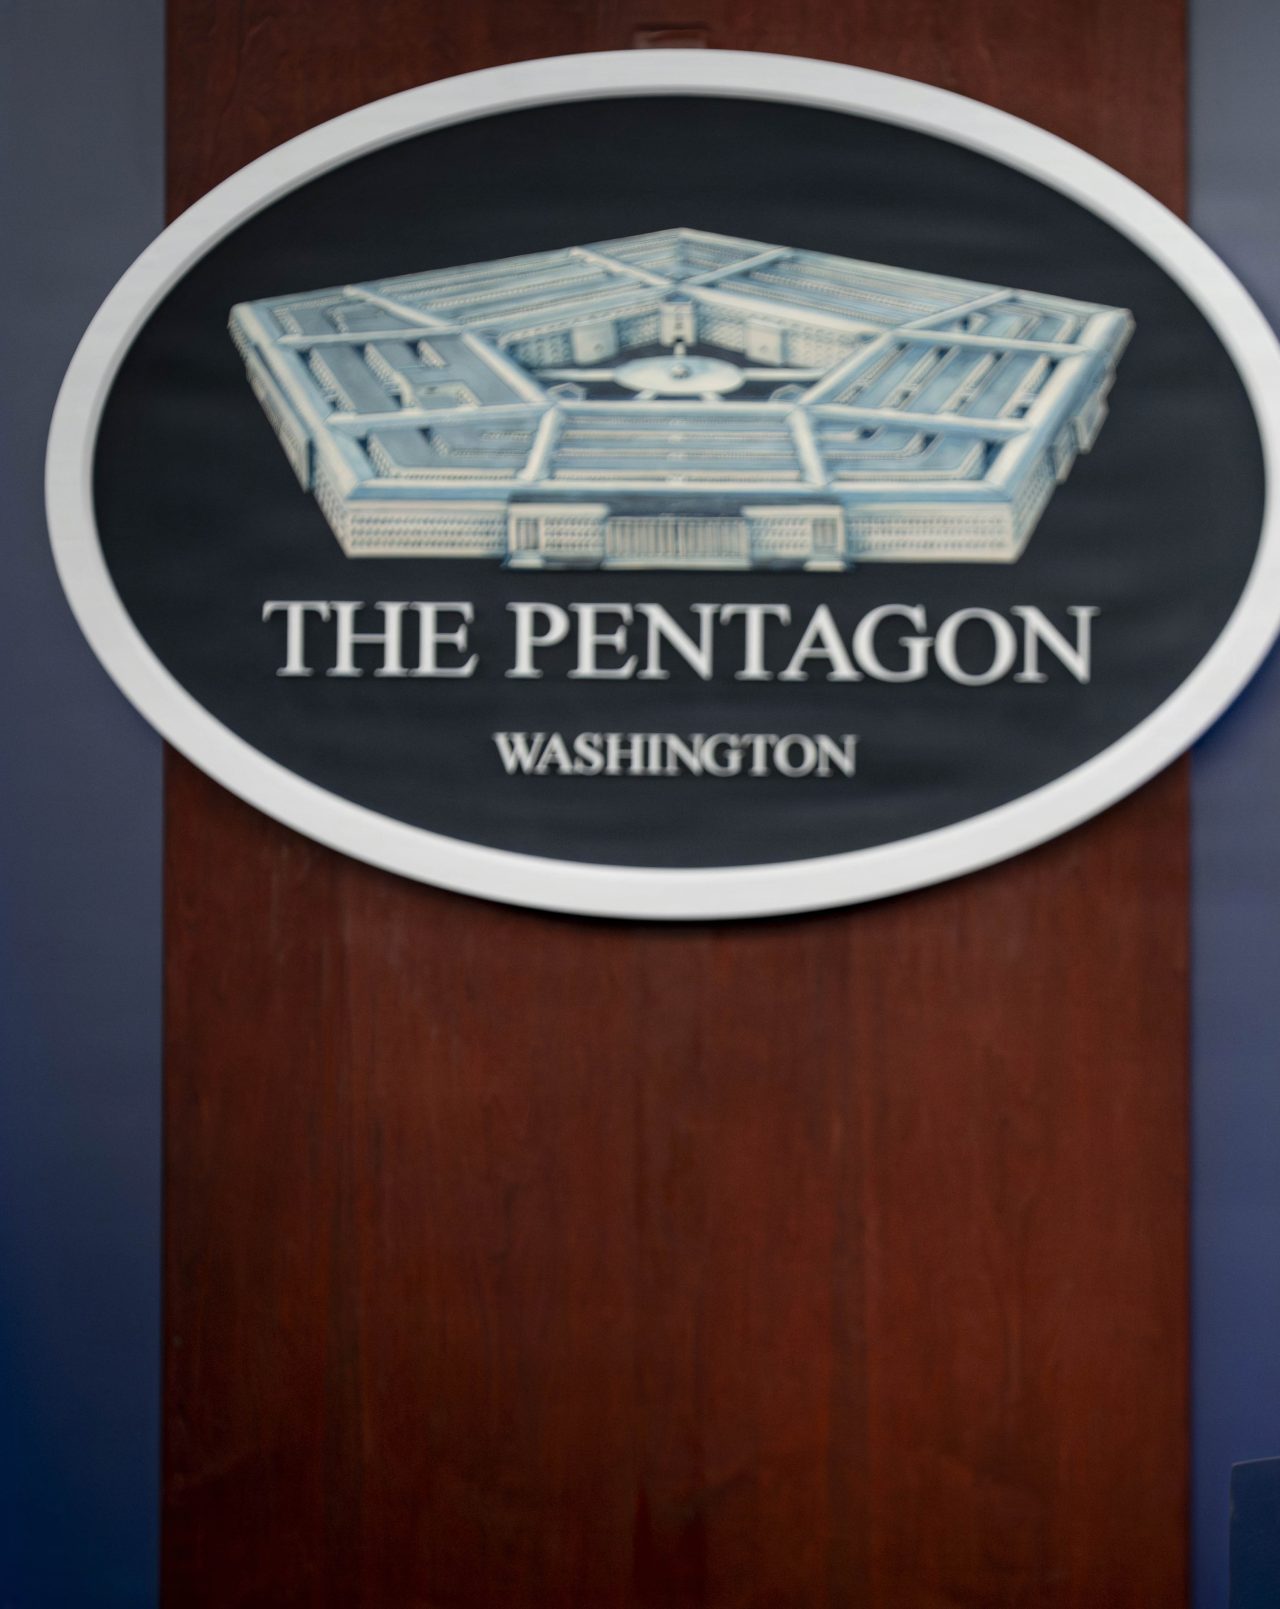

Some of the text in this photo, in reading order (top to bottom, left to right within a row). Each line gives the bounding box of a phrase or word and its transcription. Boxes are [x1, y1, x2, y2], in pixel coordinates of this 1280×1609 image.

[262, 600, 1099, 685] THE PENTAGON
[492, 731, 859, 778] WASHINGTON
